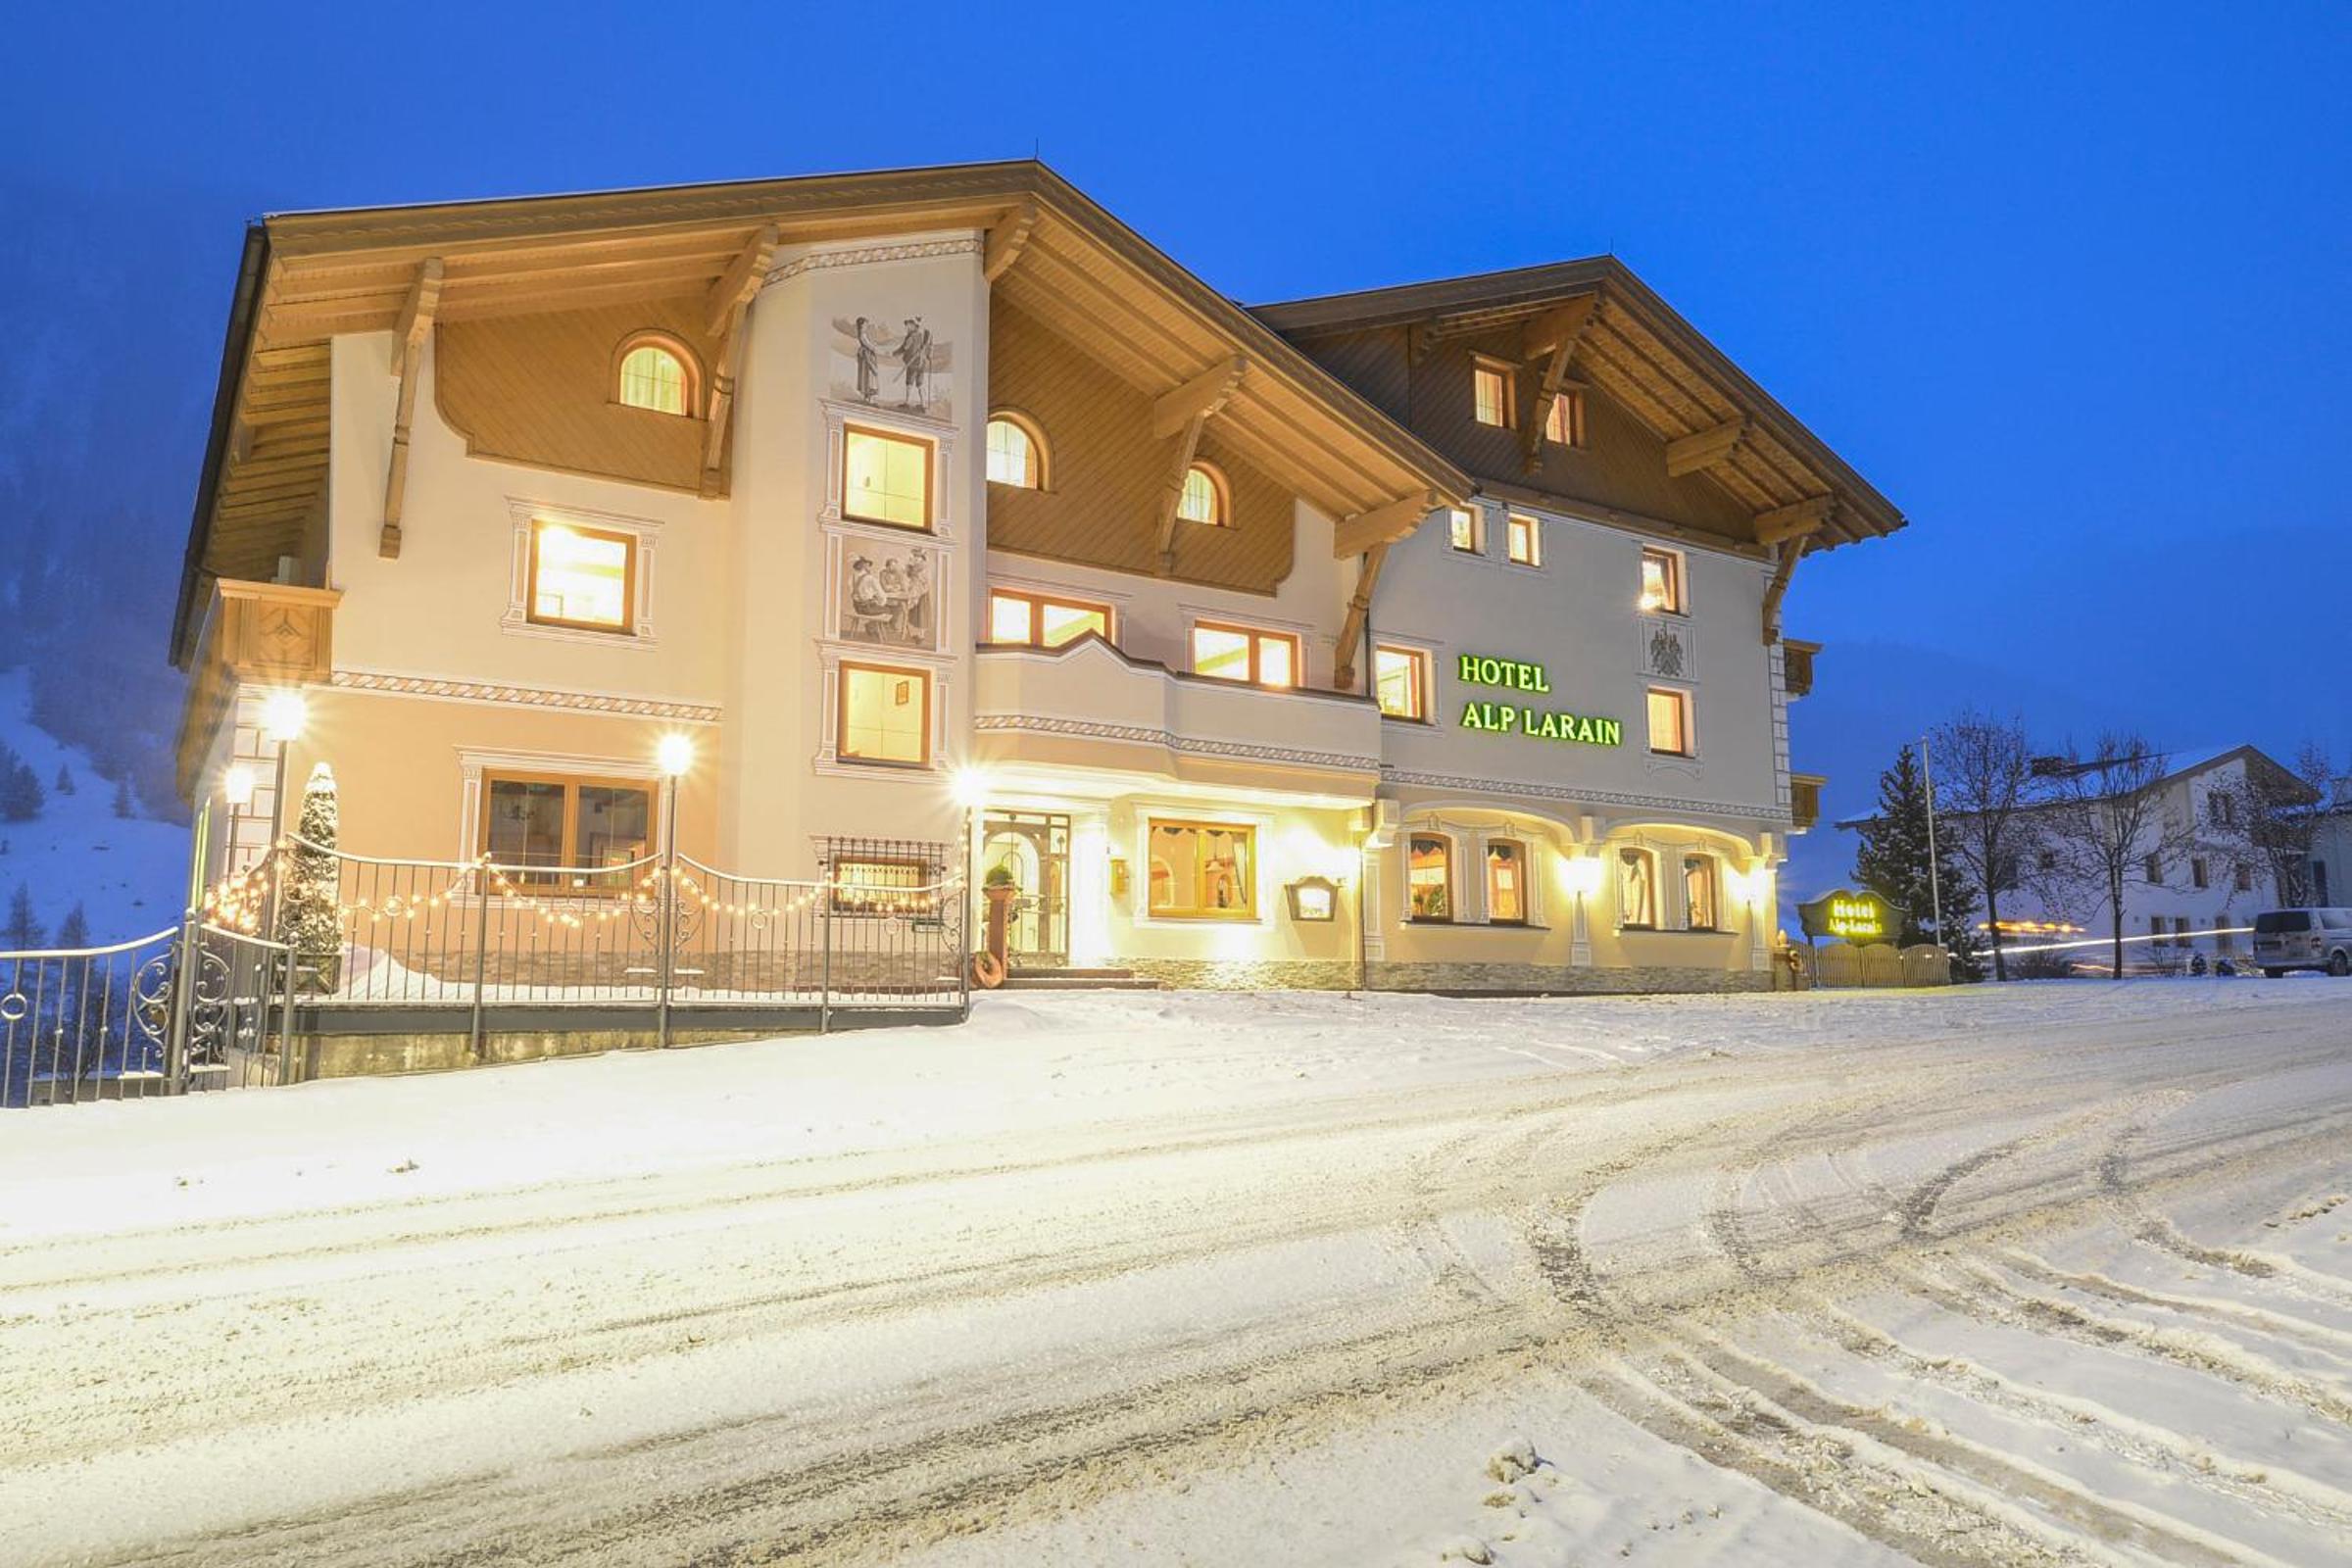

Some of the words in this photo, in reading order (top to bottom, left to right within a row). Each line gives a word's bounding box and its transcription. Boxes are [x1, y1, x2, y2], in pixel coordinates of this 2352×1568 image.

[1459, 654, 1550, 693] HOTEL
[1461, 701, 1516, 733] ALP
[1522, 708, 1622, 746] LARAIN
[1833, 899, 1876, 917] Hotel
